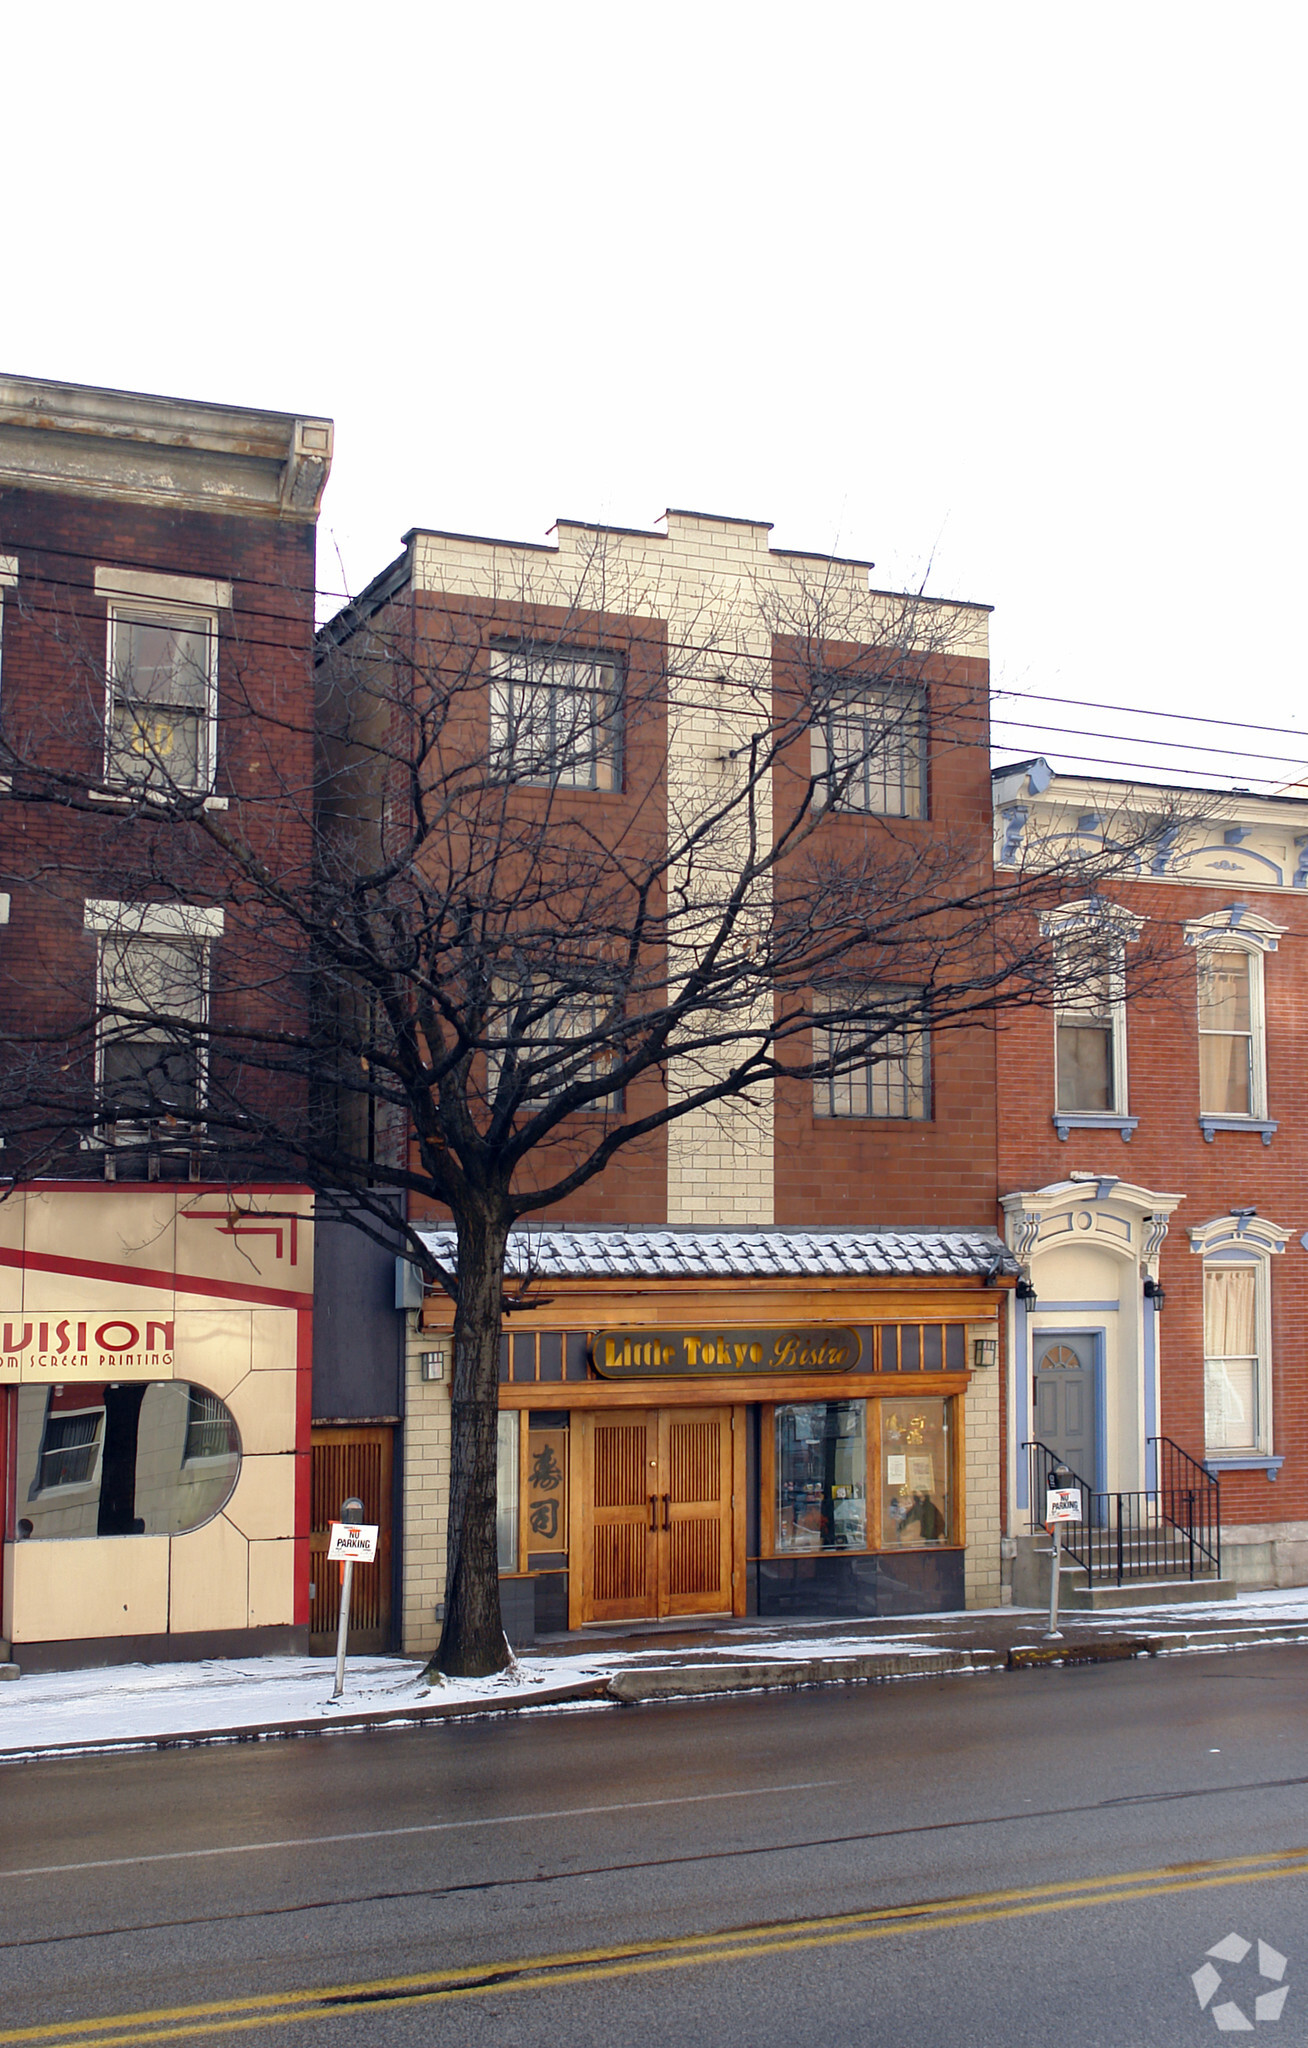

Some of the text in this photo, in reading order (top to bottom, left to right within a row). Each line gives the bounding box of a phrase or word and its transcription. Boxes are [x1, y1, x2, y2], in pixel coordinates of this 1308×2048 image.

[3, 1319, 174, 1354] VISION
[605, 1333, 850, 1368] Little Tokyo Bistro
[30, 1354, 88, 1368] SCREEN
[99, 1353, 173, 1366] PRINTING
[1052, 1501, 1078, 1510] PARKING
[337, 1539, 370, 1549] PARKING
